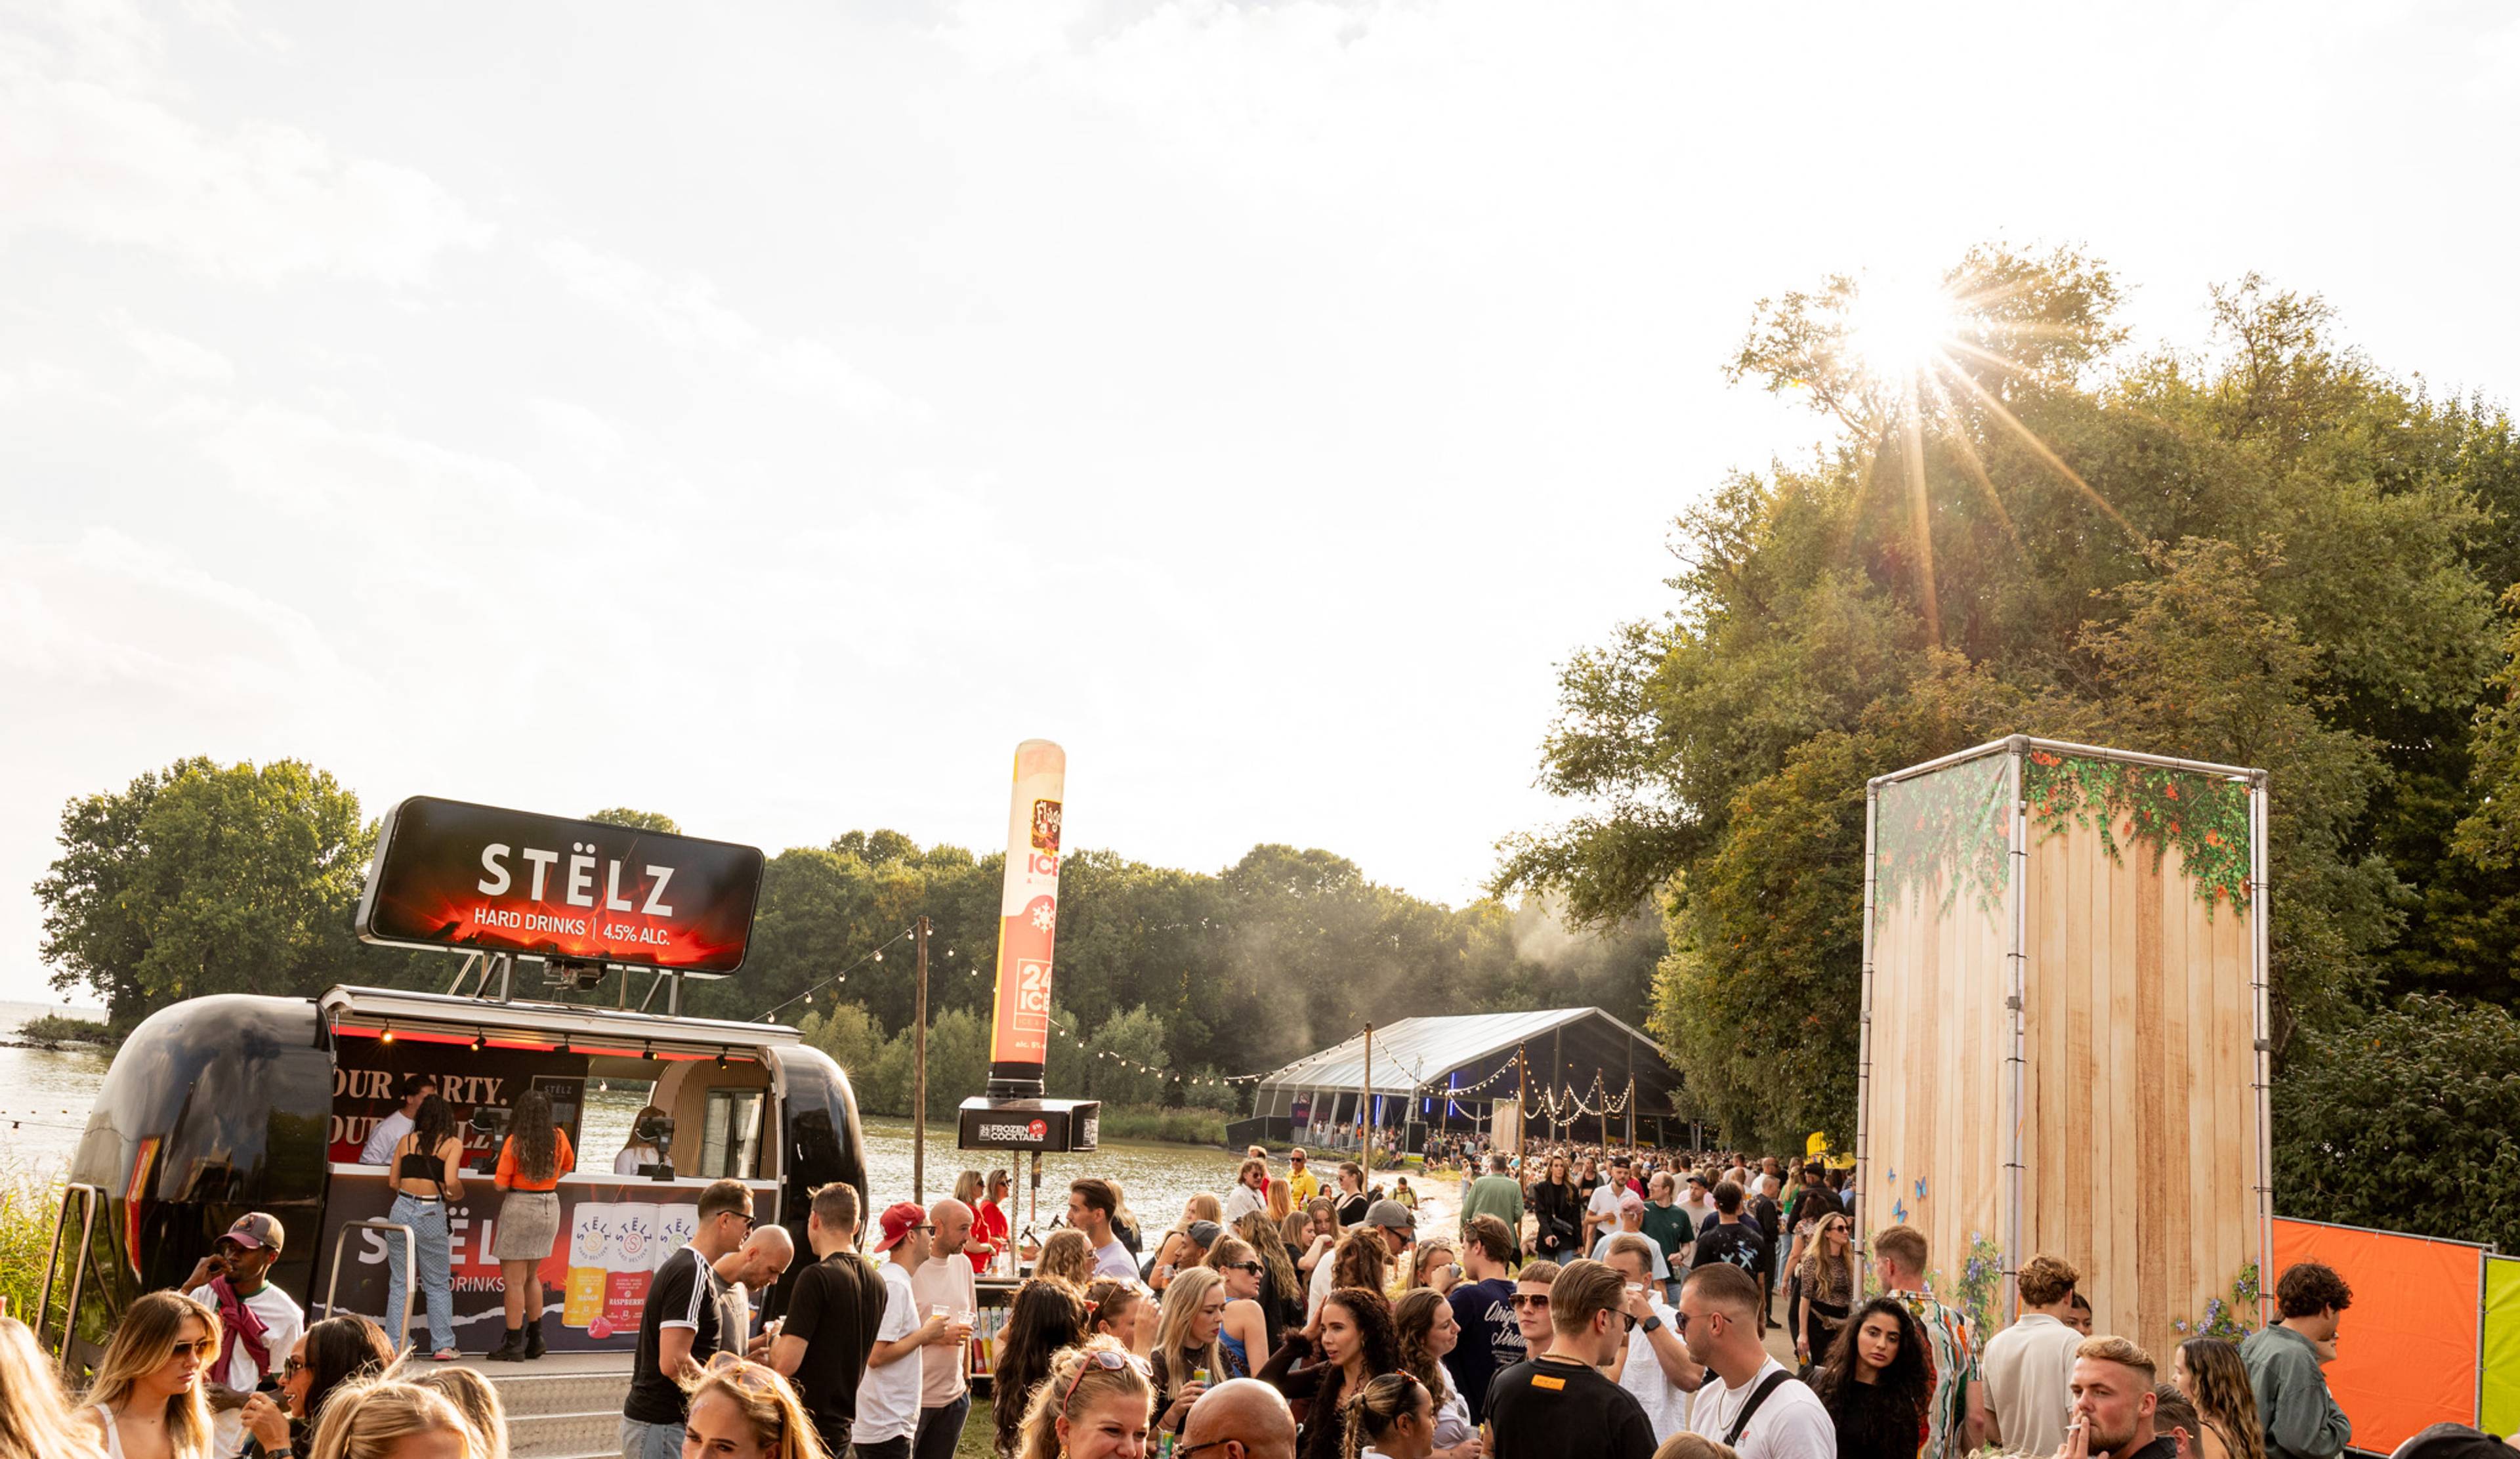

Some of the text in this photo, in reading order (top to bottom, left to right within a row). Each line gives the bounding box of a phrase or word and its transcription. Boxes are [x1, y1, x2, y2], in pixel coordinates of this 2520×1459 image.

[477, 841, 675, 917] STËLZ
[474, 907, 670, 946] HARD DRINKS 4.5% ALC.
[544, 1084, 573, 1095] STËLZ
[990, 1133, 1043, 1142] COCKTAILS
[992, 1124, 1030, 1134] FROZEN
[577, 1216, 612, 1242] STËLZ
[616, 1217, 652, 1242] STËLZ
